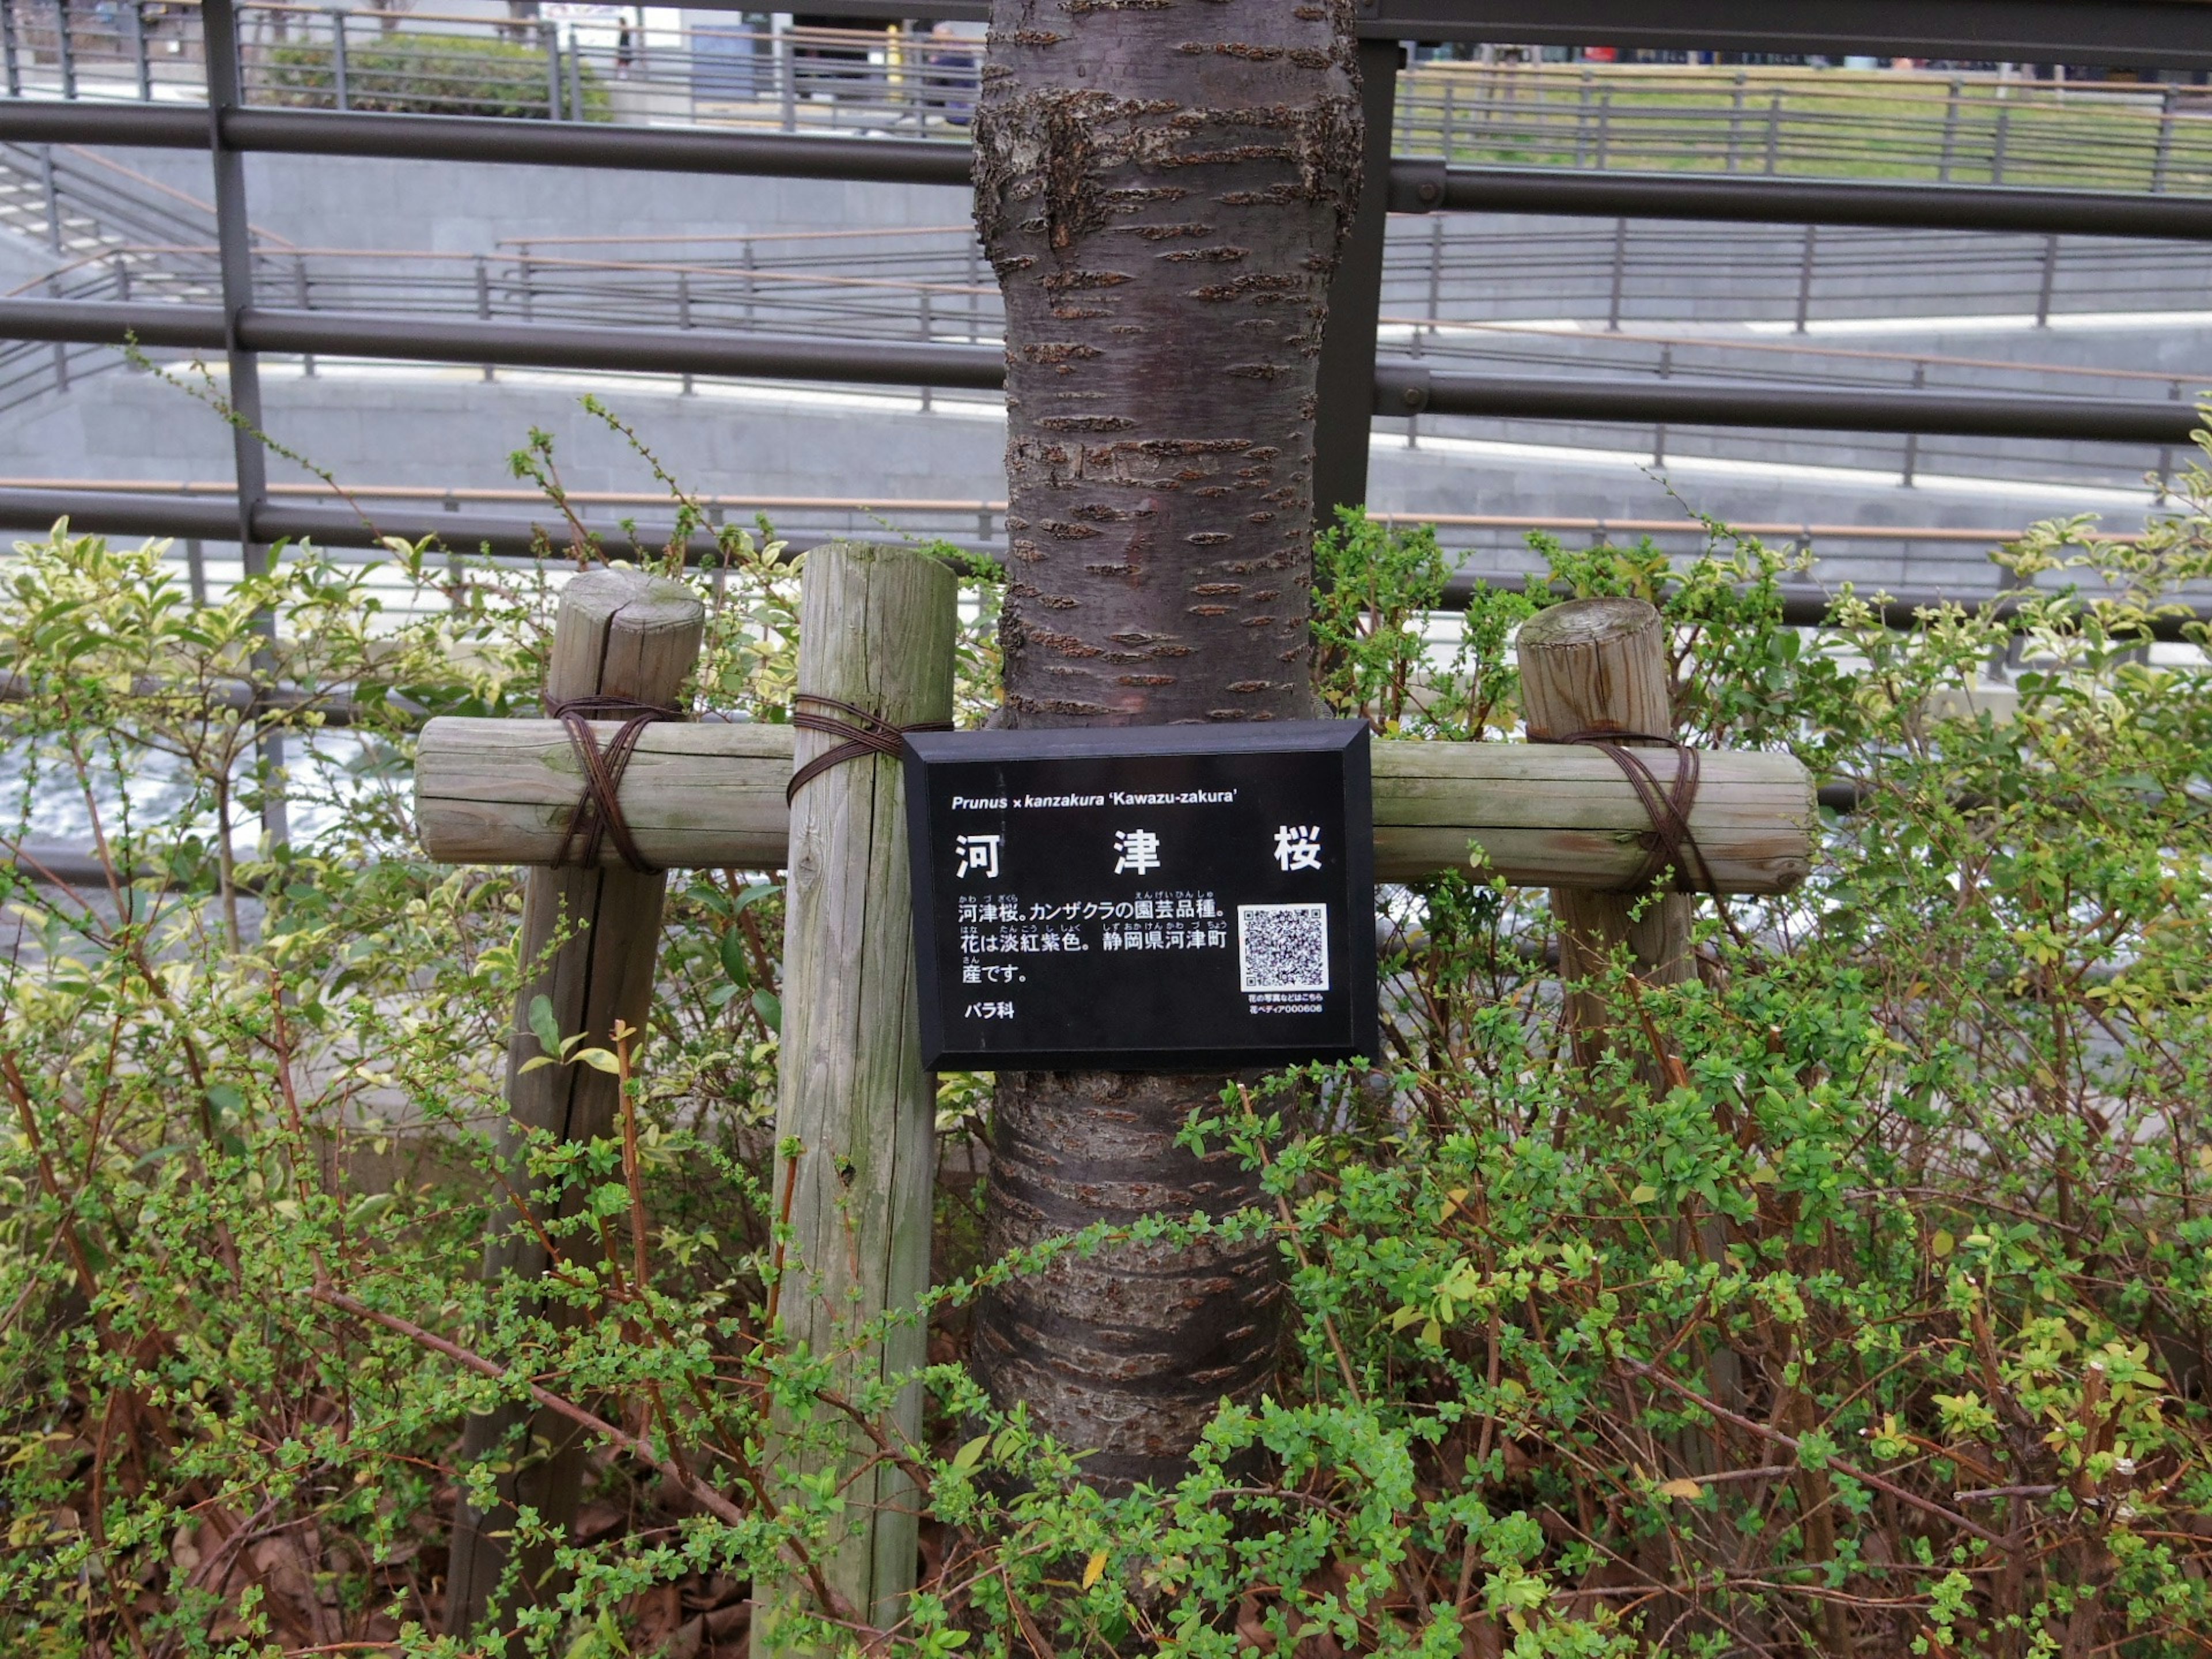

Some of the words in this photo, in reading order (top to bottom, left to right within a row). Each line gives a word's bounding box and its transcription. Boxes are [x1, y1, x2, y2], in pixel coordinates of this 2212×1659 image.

[952, 796, 1008, 810] Prunus
[1024, 793, 1105, 808] kanzakura
[955, 834, 1001, 878] 河
[1113, 828, 1161, 876] 津
[1274, 825, 1322, 871] 桜
[962, 964, 1026, 983] 産です。
[964, 1001, 1015, 1019] バラ科
